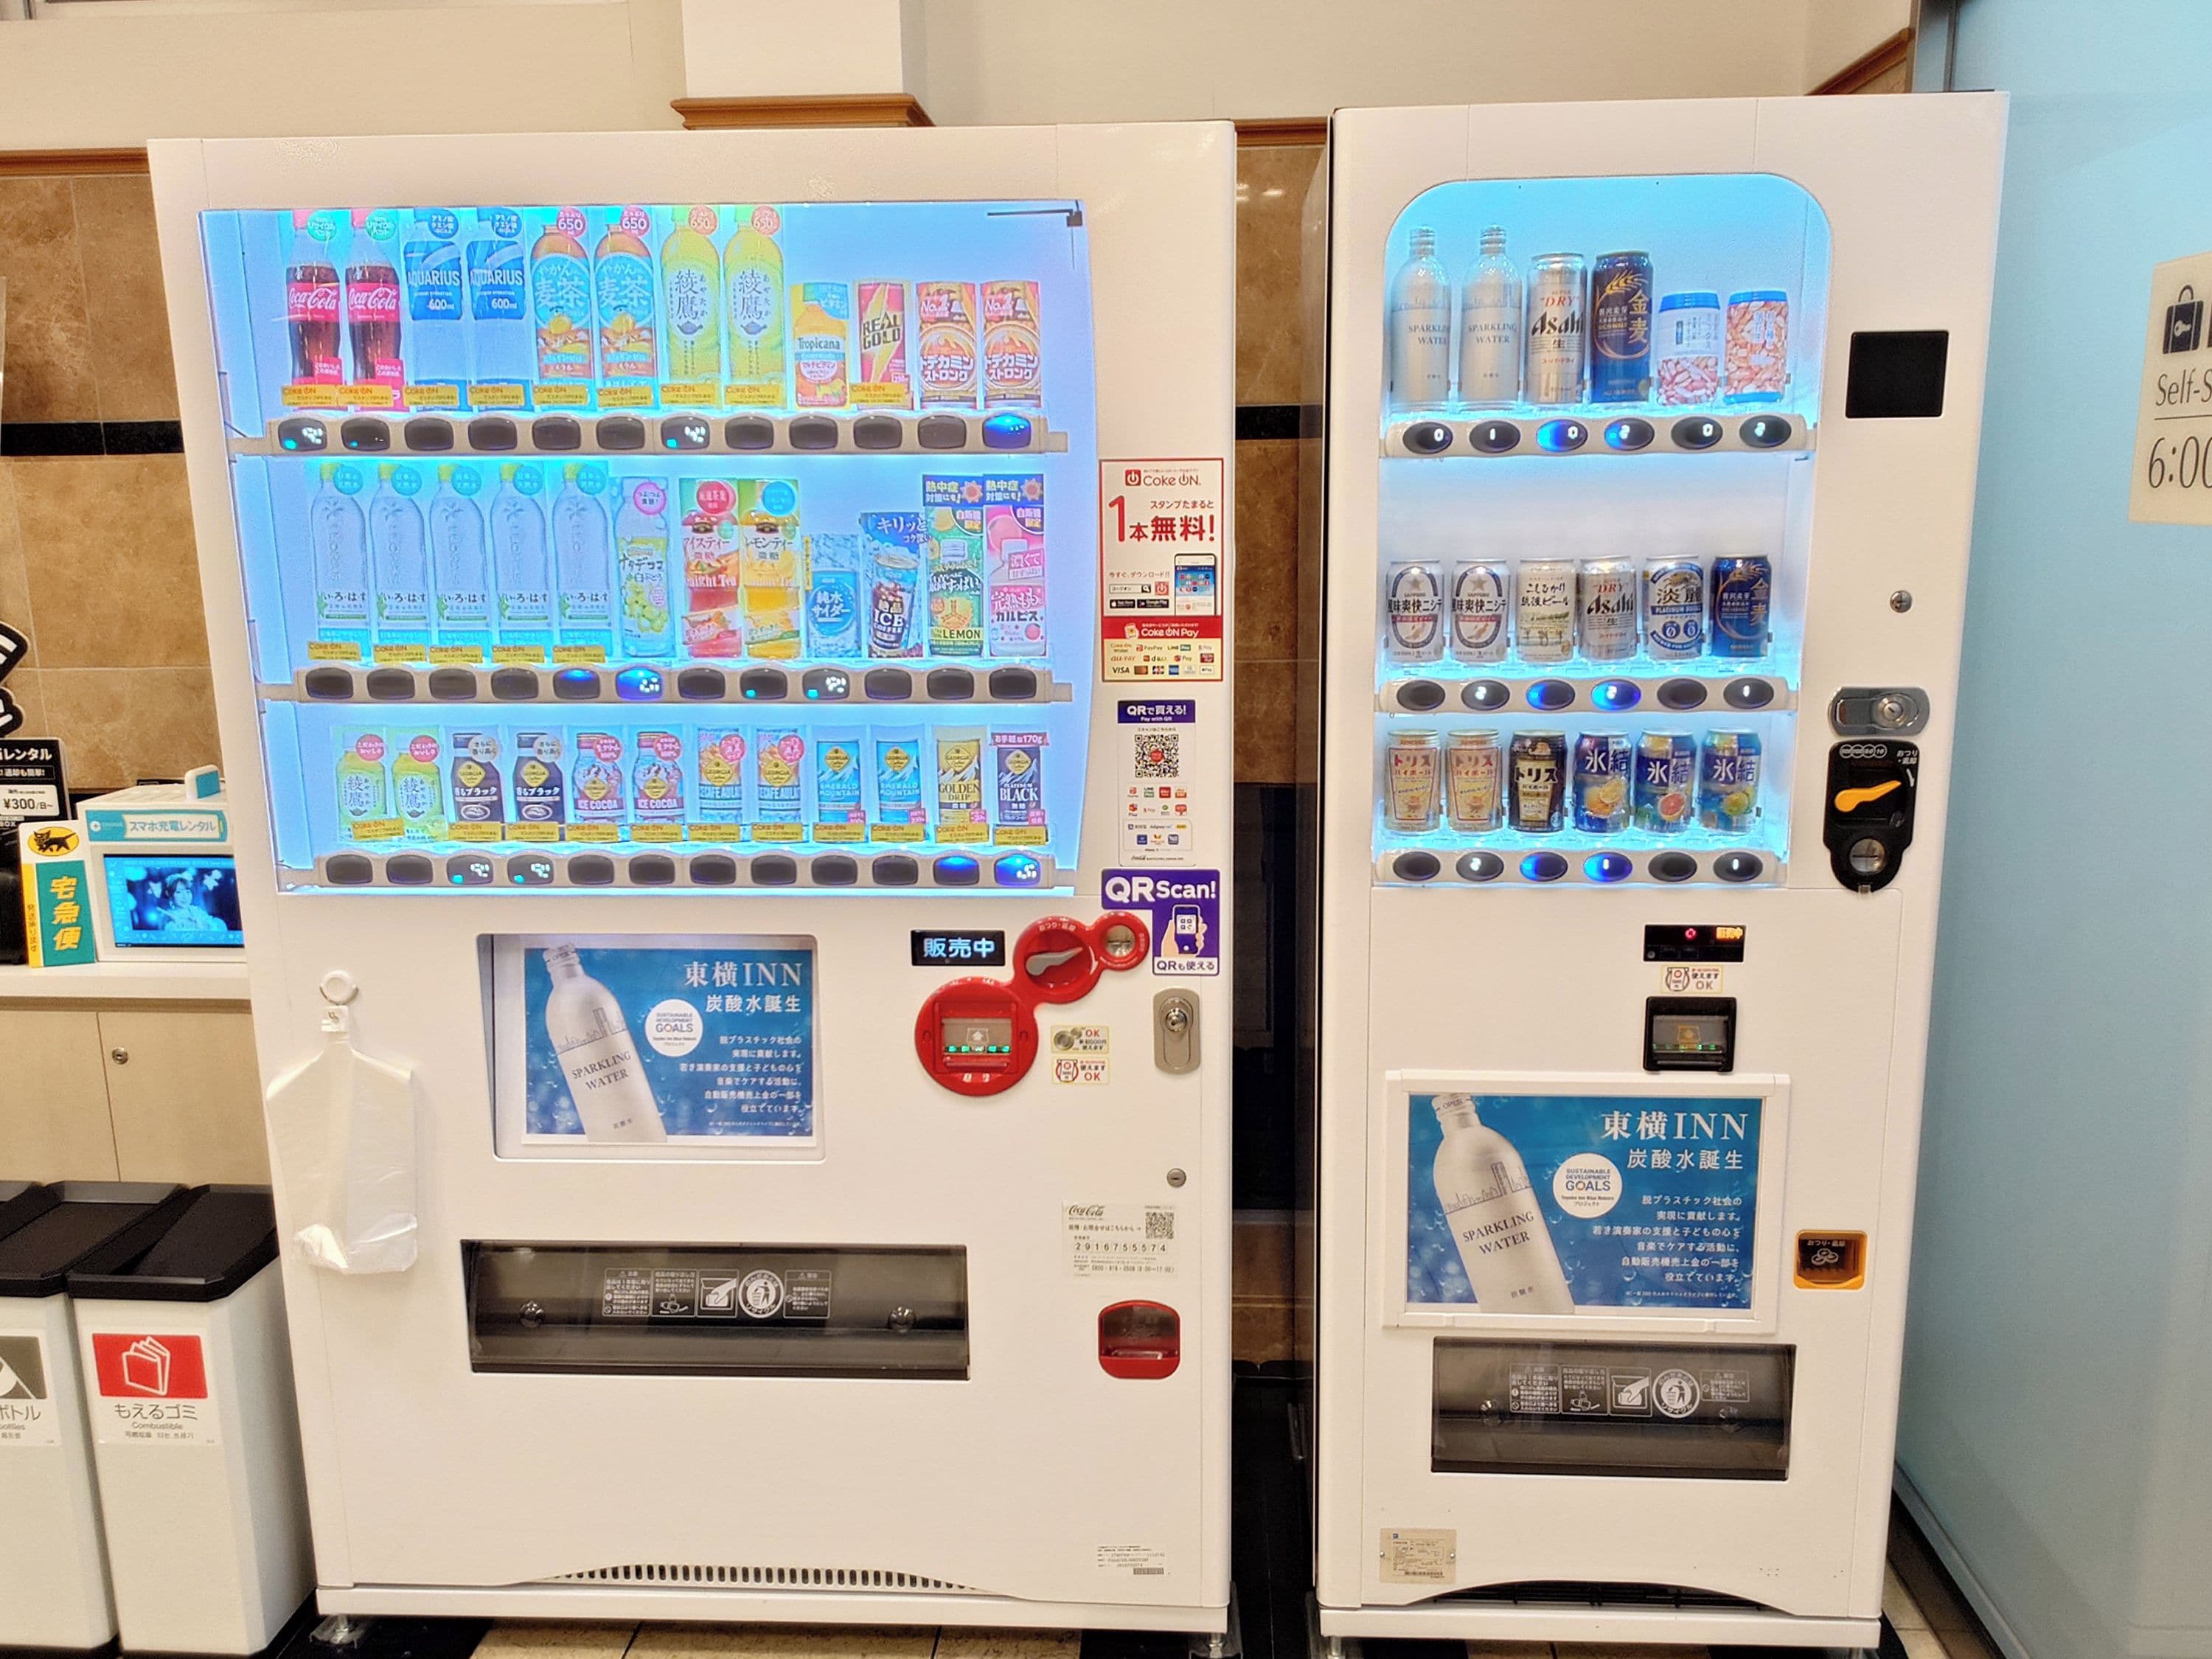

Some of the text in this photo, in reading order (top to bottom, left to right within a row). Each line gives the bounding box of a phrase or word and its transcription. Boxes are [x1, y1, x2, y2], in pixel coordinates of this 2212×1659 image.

[557, 220, 583, 230] 650
[622, 219, 647, 229] 650
[691, 220, 710, 229] 650
[754, 220, 773, 229] 650
[408, 271, 461, 286] AQUARIUS
[470, 270, 524, 285] AQUARIUS
[536, 276, 585, 308] 麦茶
[599, 276, 649, 308] 麦茶
[675, 269, 698, 320] 綾鷹
[738, 269, 764, 320] 綾鷹
[288, 288, 338, 310] Coca-Cola
[347, 288, 397, 310] Coca-Cola
[1544, 295, 1576, 307] DRY
[1531, 310, 1585, 336] Asahi
[1627, 289, 1649, 344] 金麦
[863, 312, 900, 335] REAL
[1468, 323, 1517, 332] SPARKLING
[798, 338, 840, 350] Tropicana
[863, 327, 900, 350] GOLD
[1475, 335, 1510, 344] WATER
[1552, 338, 1565, 349] 生
[924, 369, 967, 381] ストロング
[990, 368, 1032, 380] ストロング
[1144, 473, 1199, 486] Coke ON
[1150, 500, 1214, 509] スタンプたまると
[1108, 495, 1215, 542] 1本無料!
[877, 516, 927, 535] キリッと
[684, 536, 730, 549] アイスティー
[745, 536, 793, 549] レモンティー
[1526, 582, 1565, 594] こしひかり
[1597, 582, 1624, 593] DRY
[816, 591, 844, 604] 純水
[1520, 595, 1570, 607] 越後ビール
[1587, 592, 1634, 615] Asahi
[1750, 577, 1770, 626] 金麦
[812, 603, 851, 618] サイダー
[996, 611, 1038, 622] カルピス
[874, 609, 904, 626] ICE
[943, 629, 981, 639] LEMON
[1141, 627, 1199, 639] Coke ON Pay
[1127, 705, 1186, 717] QRで買える!
[1394, 754, 1431, 767] トリス
[1455, 754, 1493, 767] トリス
[1585, 748, 1630, 773] 氷結
[1514, 766, 1558, 784] トリス
[1646, 760, 1691, 785] 氷結
[1713, 758, 1756, 782] 氷結
[939, 783, 980, 793] GOLDEN
[1000, 787, 1038, 801] BLACK
[590, 800, 618, 809] COCOA
[650, 799, 678, 808] COCOA
[129, 821, 216, 832] スマホ充電レンタル
[1105, 876, 1216, 903] QR Scan!
[50, 875, 81, 950] 宅急便
[923, 937, 995, 958] 販売中
[1156, 960, 1215, 971] QRも使える
[684, 961, 803, 987] 東横INN
[1695, 981, 1714, 990] OK
[706, 995, 801, 1013] 炭酸水誕生
[655, 1023, 693, 1033] GOALS
[1085, 1029, 1100, 1037] OK
[720, 1035, 801, 1044] 脱プラスチック社会の
[571, 1051, 631, 1079] SPARKLING
[585, 1068, 628, 1091] WATER
[1084, 1071, 1101, 1081] OK
[1601, 1110, 1749, 1141] 東横INN
[1627, 1148, 1744, 1169] 炭酸水誕生
[1565, 1180, 1611, 1192] GOALS
[1642, 1195, 1742, 1206] 脱プラスチック社会の
[1068, 1205, 1105, 1217] Coca-Cola
[1657, 1211, 1741, 1221] 実現に貢献します。
[1462, 1210, 1534, 1242] SPARKLING
[1593, 1225, 1741, 1238] 若き演奏家の支援と子どもの心を
[1479, 1231, 1530, 1254] WATER
[1637, 1242, 1740, 1253] 音楽でケアする活動に、
[1621, 1256, 1739, 1268] 自動販売機売上金の一部を
[1665, 1272, 1739, 1283] 役立てています。
[114, 1403, 198, 1420] もえるゴミ
[1661, 1402, 1693, 1414] リサイクル
[131, 1422, 184, 1430] Combustible
